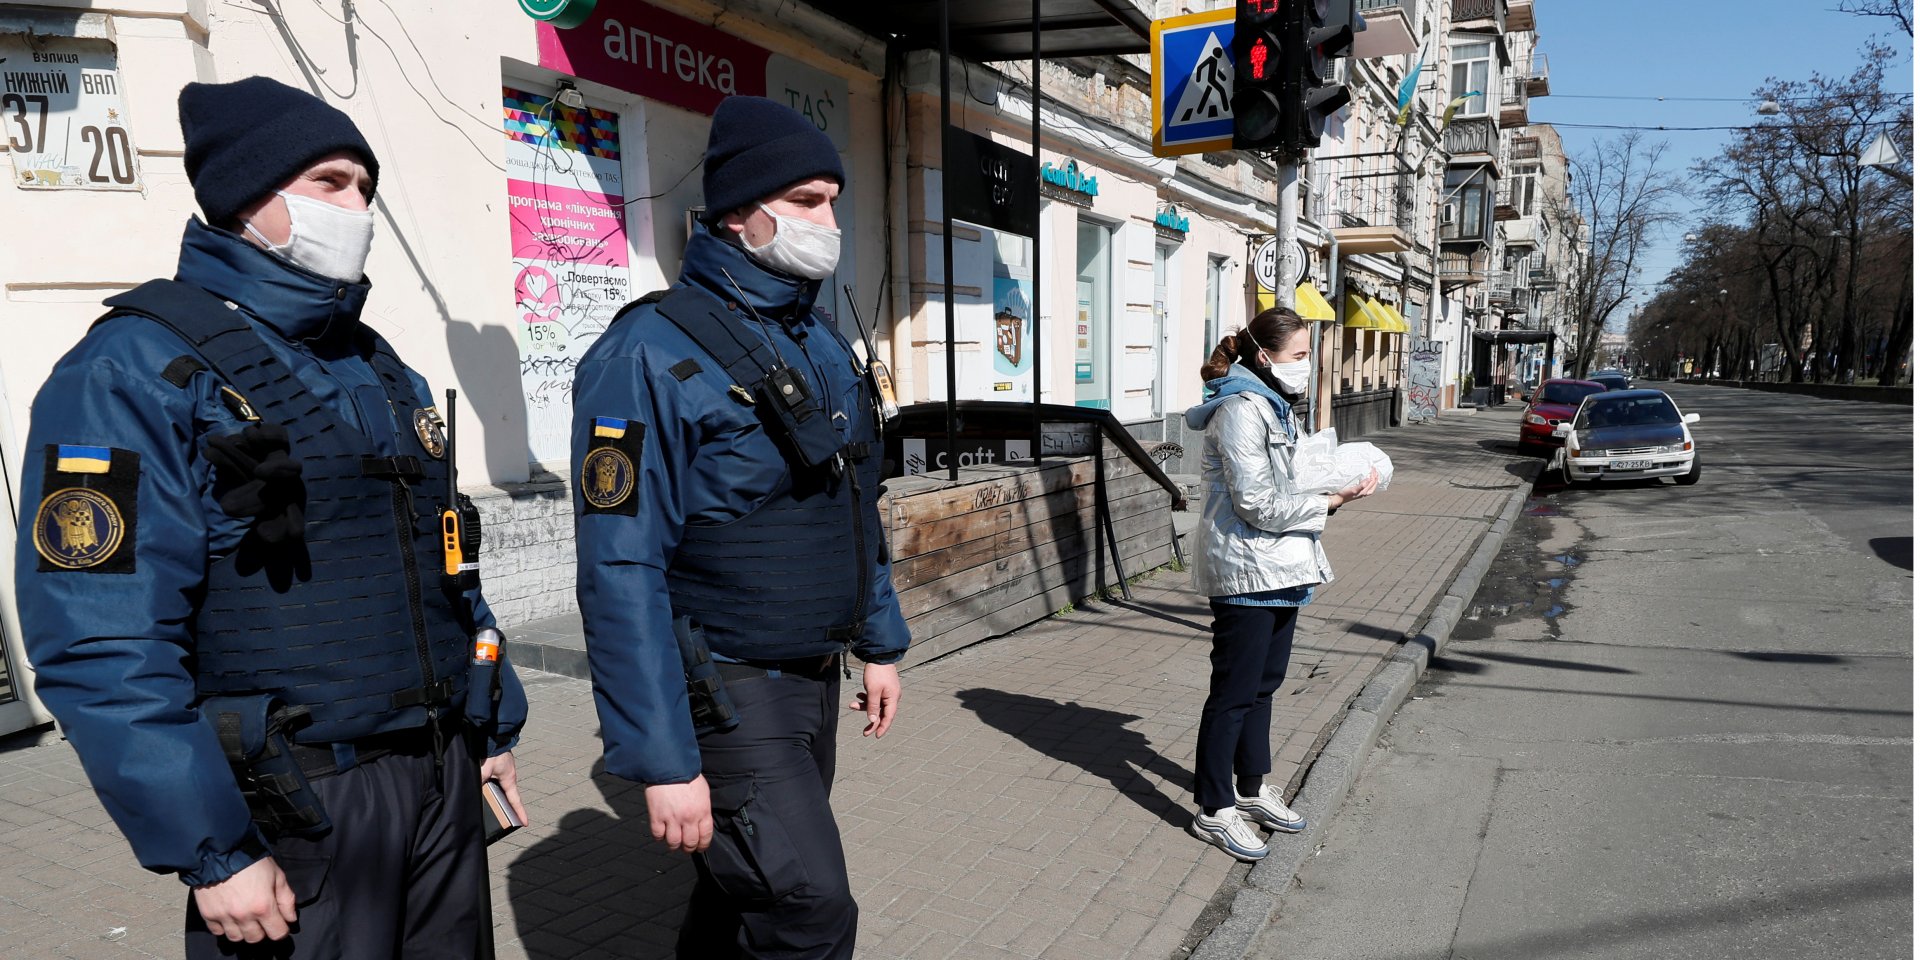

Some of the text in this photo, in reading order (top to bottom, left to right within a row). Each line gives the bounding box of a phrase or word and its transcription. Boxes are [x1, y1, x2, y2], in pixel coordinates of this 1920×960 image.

[604, 18, 737, 96] аптека
[4, 70, 117, 95] НИЖНІЙ ВАЛ
[785, 87, 828, 131] TAS
[541, 216, 596, 232] хронічних
[936, 446, 995, 469] caft
